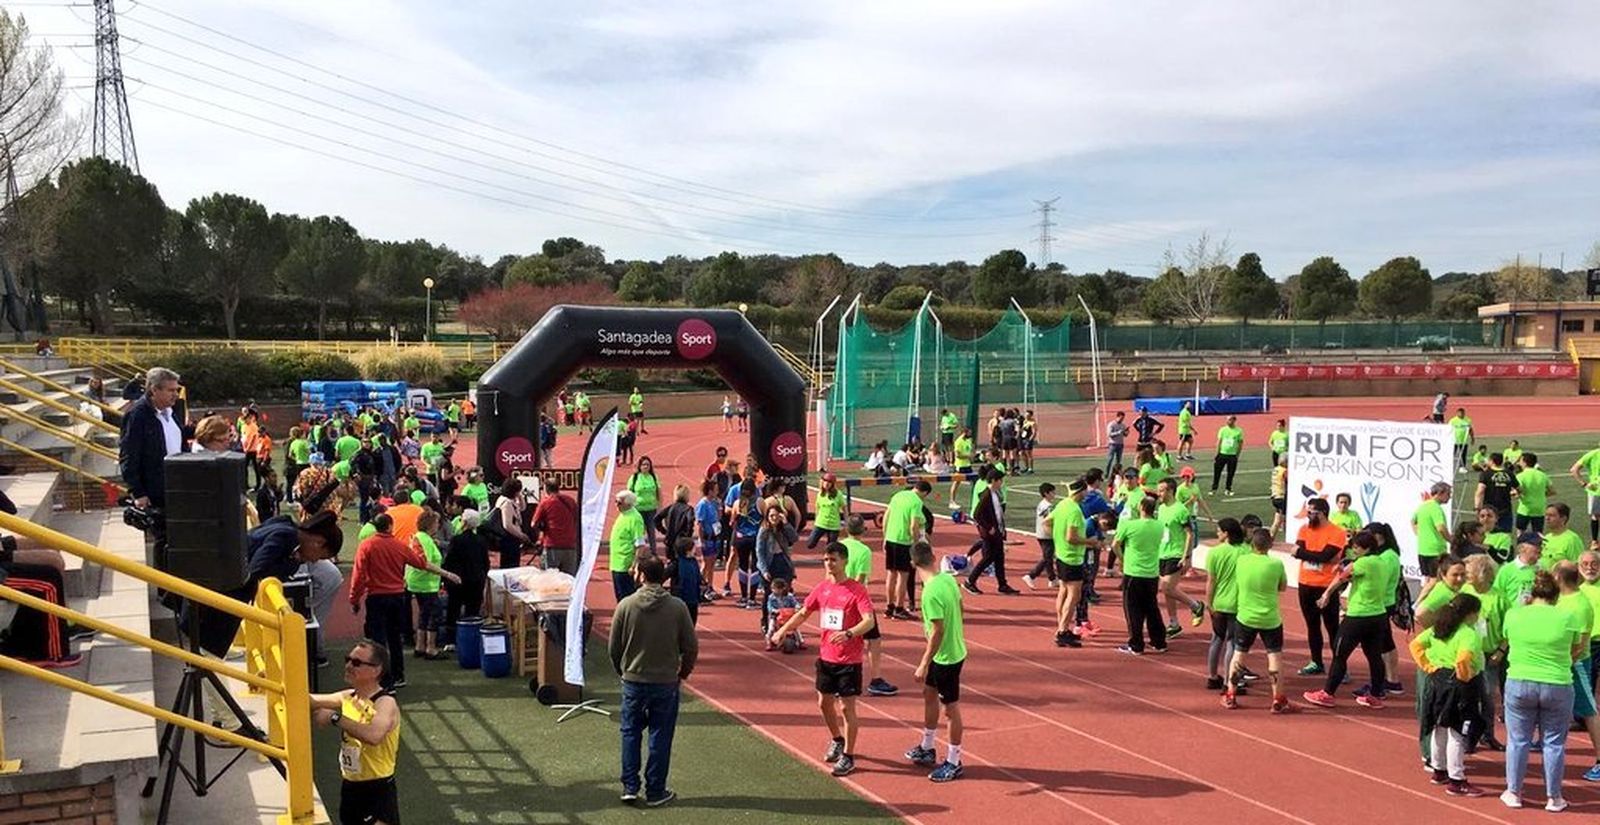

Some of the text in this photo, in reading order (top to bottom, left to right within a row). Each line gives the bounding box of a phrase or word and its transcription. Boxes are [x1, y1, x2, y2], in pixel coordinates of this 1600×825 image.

[598, 328, 672, 347] Santagadea
[682, 332, 712, 347] Sport
[776, 444, 802, 457] Sport
[1294, 432, 1441, 463] RUN FOR
[501, 451, 532, 464] Sport
[1294, 454, 1444, 484] PARKINSON'S
